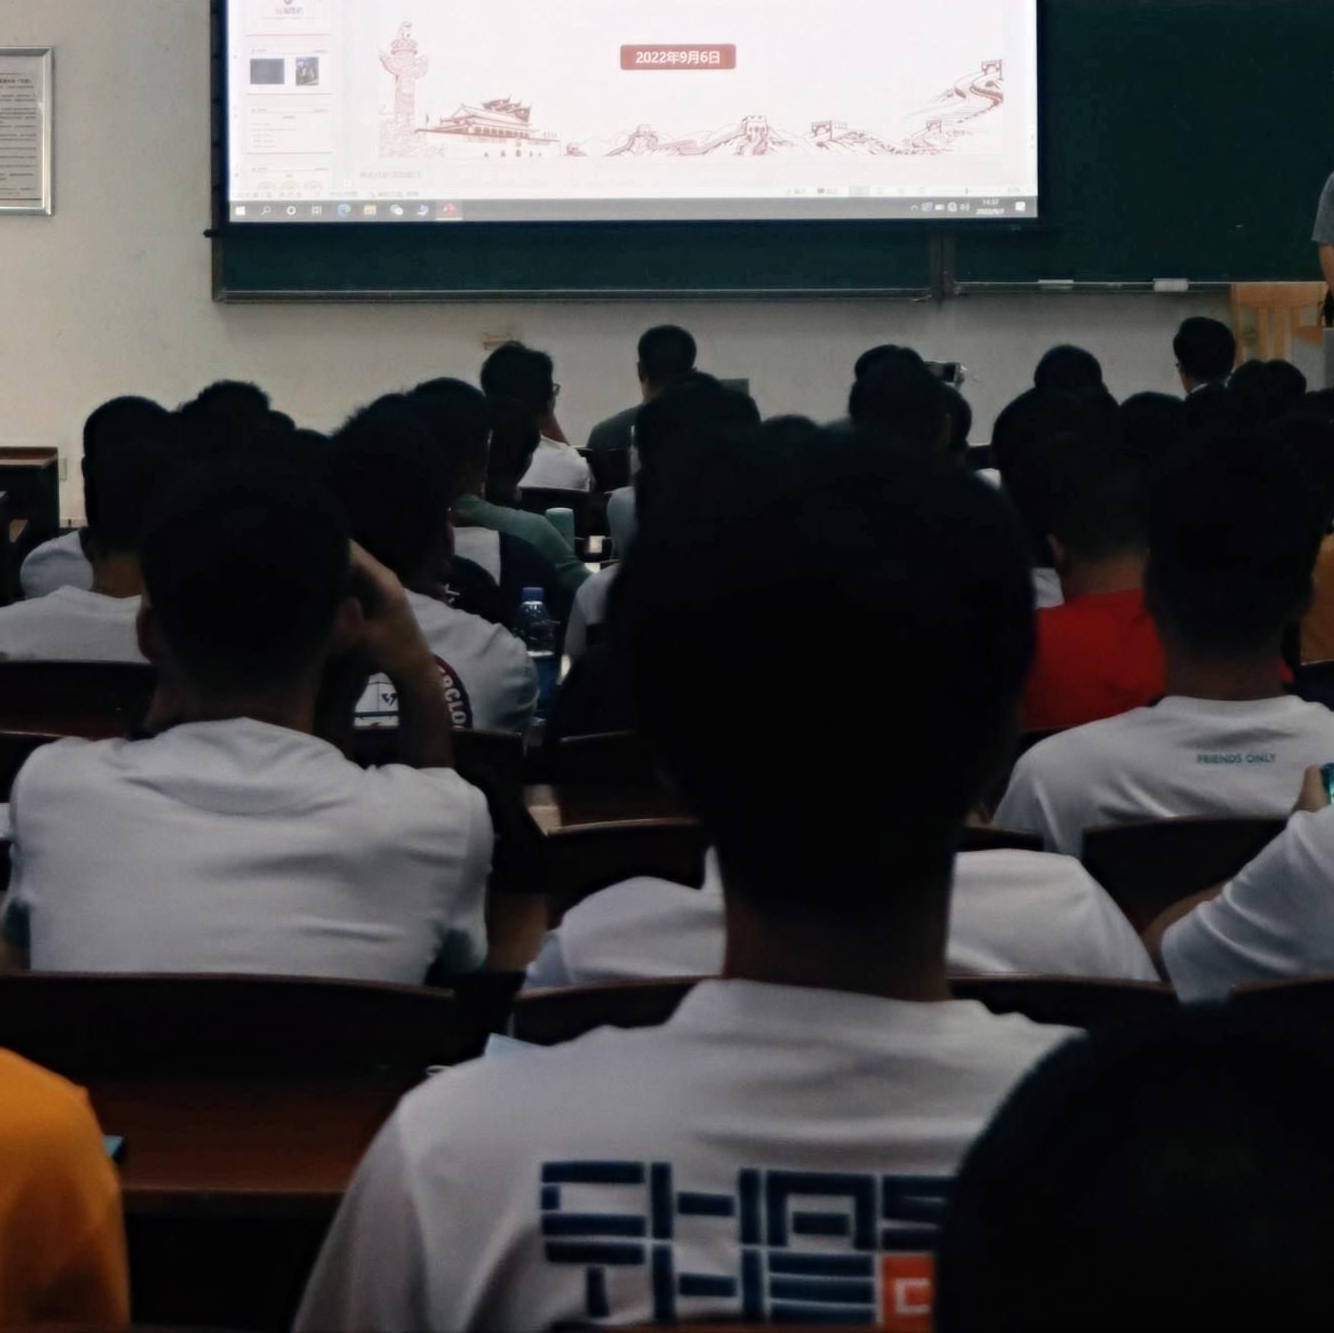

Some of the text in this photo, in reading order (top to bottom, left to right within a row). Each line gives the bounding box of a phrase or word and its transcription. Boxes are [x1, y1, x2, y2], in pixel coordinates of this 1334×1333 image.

[636, 51, 720, 64] 2022年9月6日
[1197, 753, 1276, 763] FRIENDS ONLY
